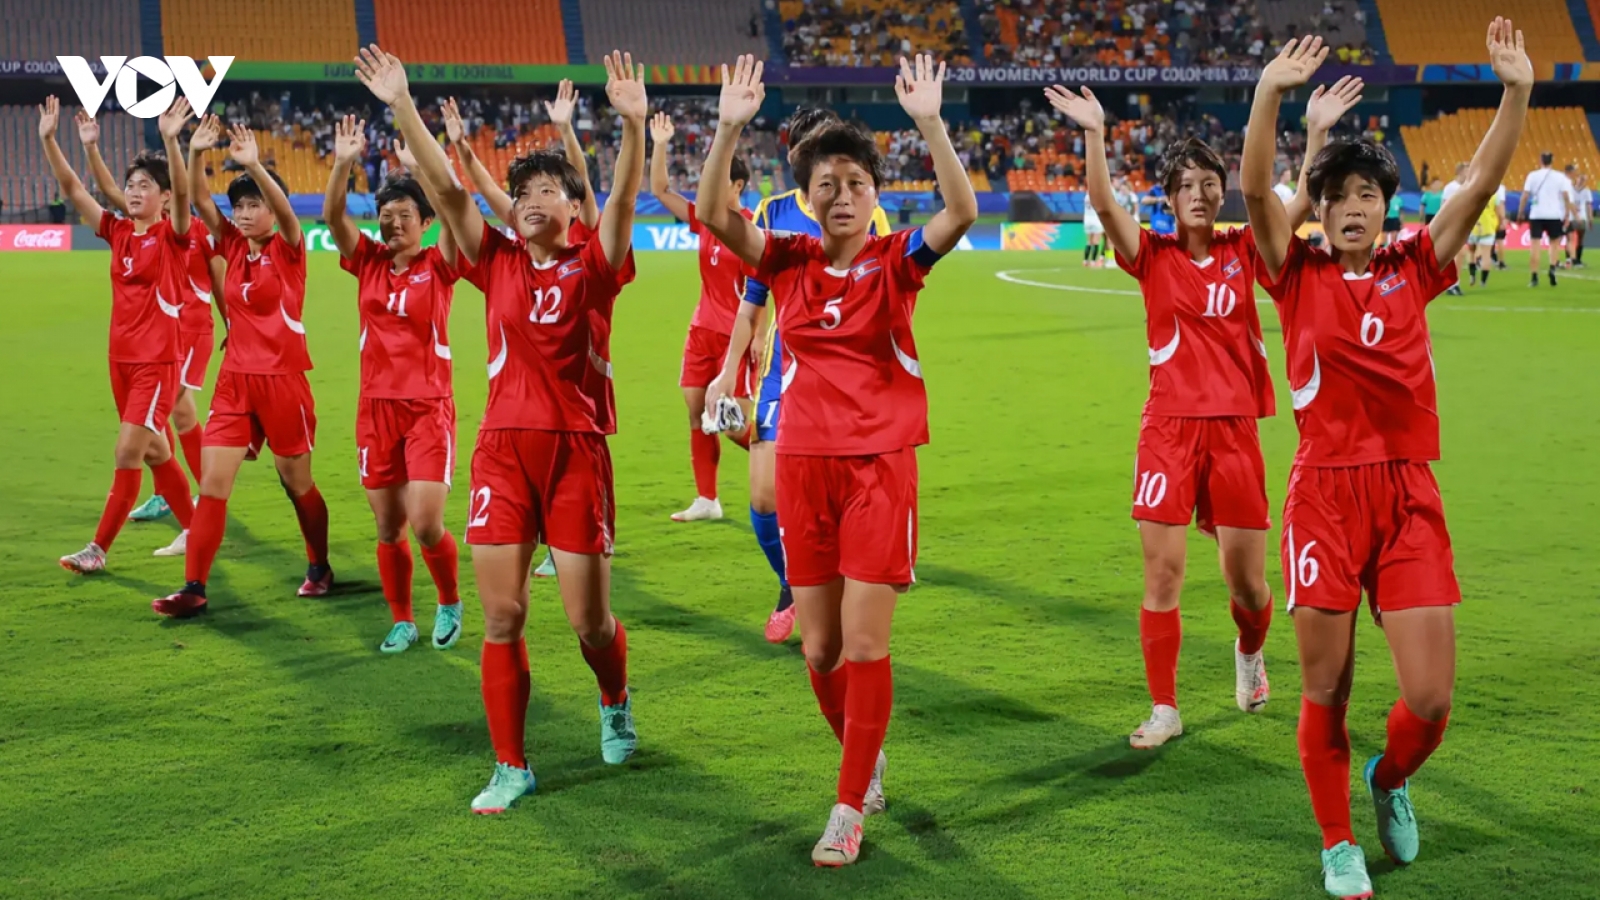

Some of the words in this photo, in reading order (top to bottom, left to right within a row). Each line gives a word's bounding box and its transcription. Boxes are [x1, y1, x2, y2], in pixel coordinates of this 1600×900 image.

[0, 60, 21, 73] UP
[979, 67, 1056, 82] WOMEN'S
[1060, 67, 1120, 82] WORLD
[1124, 67, 1157, 82] CUP
[122, 256, 134, 276] 9
[710, 245, 721, 266] 3
[240, 281, 256, 303] 7
[386, 288, 408, 317] 11
[528, 285, 562, 324] 12
[1202, 282, 1236, 317] 10
[820, 297, 843, 330] 5
[1360, 312, 1384, 346] 6
[760, 400, 778, 428] 1
[1134, 470, 1167, 508] 10
[1298, 540, 1319, 587] 6
